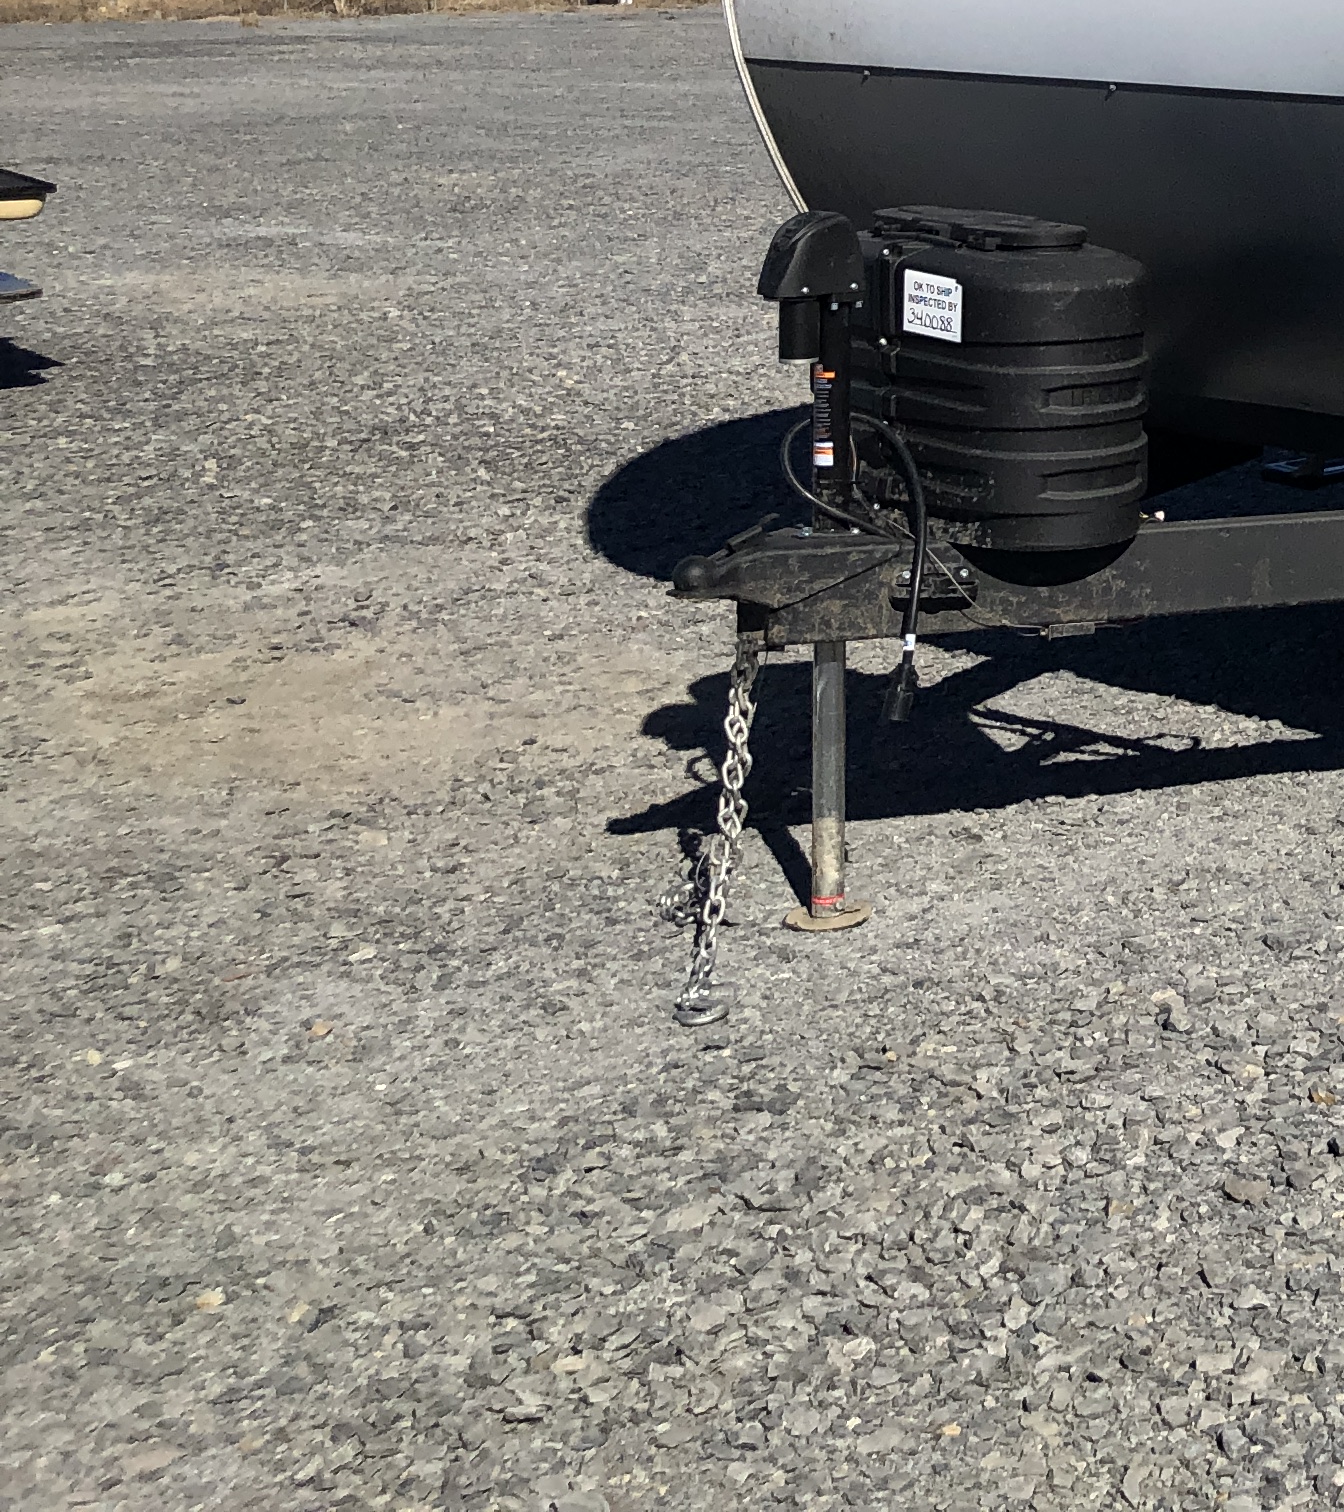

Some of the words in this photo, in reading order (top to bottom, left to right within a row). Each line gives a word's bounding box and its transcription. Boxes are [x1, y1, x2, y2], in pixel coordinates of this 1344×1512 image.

[913, 281, 924, 292] OK
[926, 283, 935, 294] TO
[937, 286, 952, 296] SHIP
[908, 294, 946, 310] INSPECTED
[948, 302, 958, 312] BY
